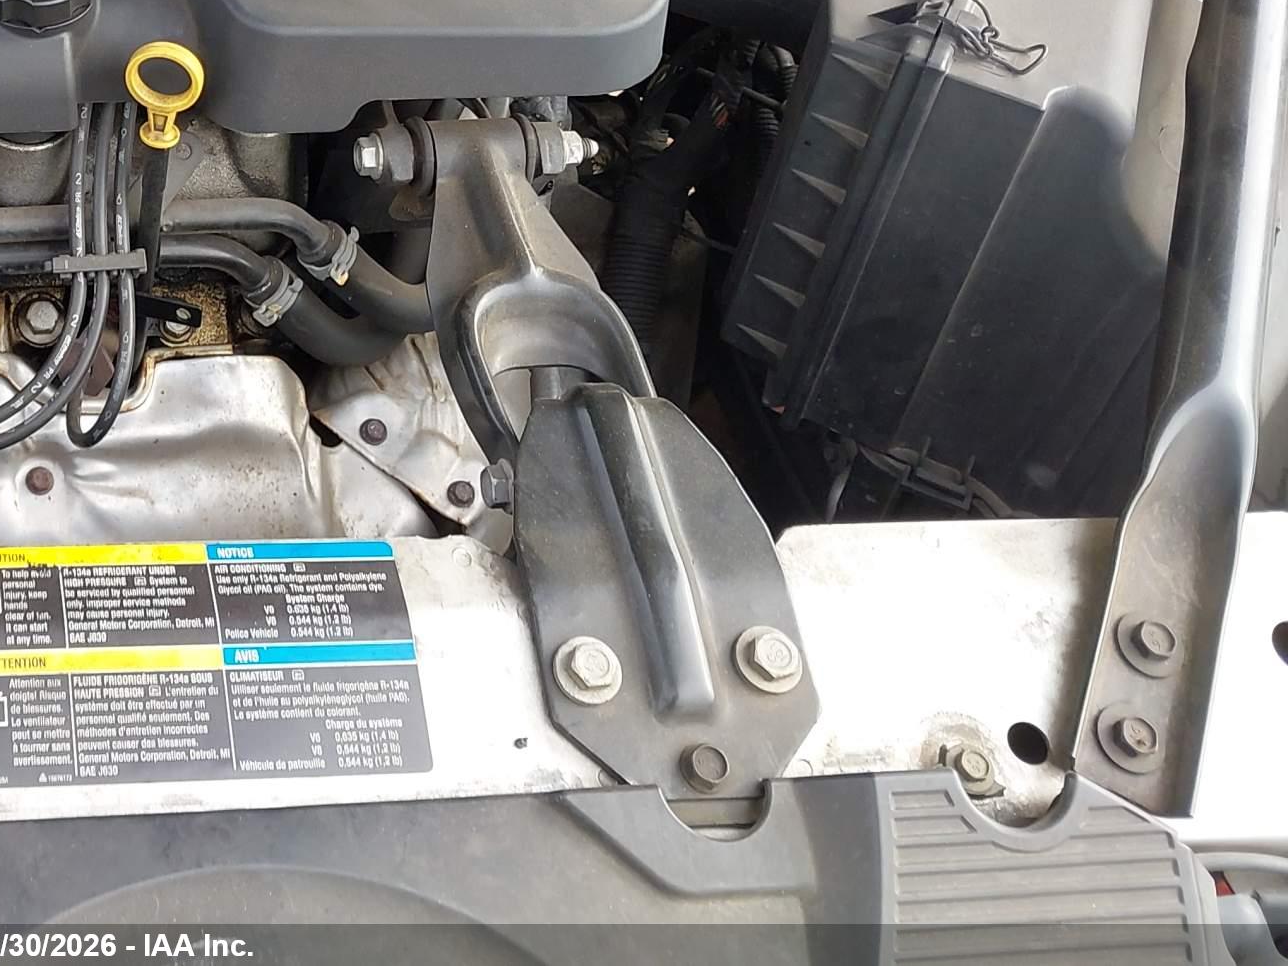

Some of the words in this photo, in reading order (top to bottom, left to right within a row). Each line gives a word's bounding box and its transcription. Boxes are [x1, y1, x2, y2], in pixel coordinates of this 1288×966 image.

[217, 547, 254, 558] NOTICE
[93, 566, 146, 576] REFRIGERANT
[149, 566, 176, 574] UNDER
[214, 565, 228, 574] AIR
[230, 564, 286, 573] CONDITIONING
[64, 578, 83, 587] HIGH
[85, 577, 126, 587] PRESSURE
[69, 621, 98, 631] General
[100, 620, 126, 630] Motors
[235, 649, 259, 663] AVIS
[74, 675, 102, 687] FLUIDE
[230, 671, 283, 683] CLIMATISEUR
[74, 689, 101, 699] HAUTE
[103, 687, 144, 699] PRESSION
[79, 752, 109, 764] General
[112, 752, 138, 762] Motors
